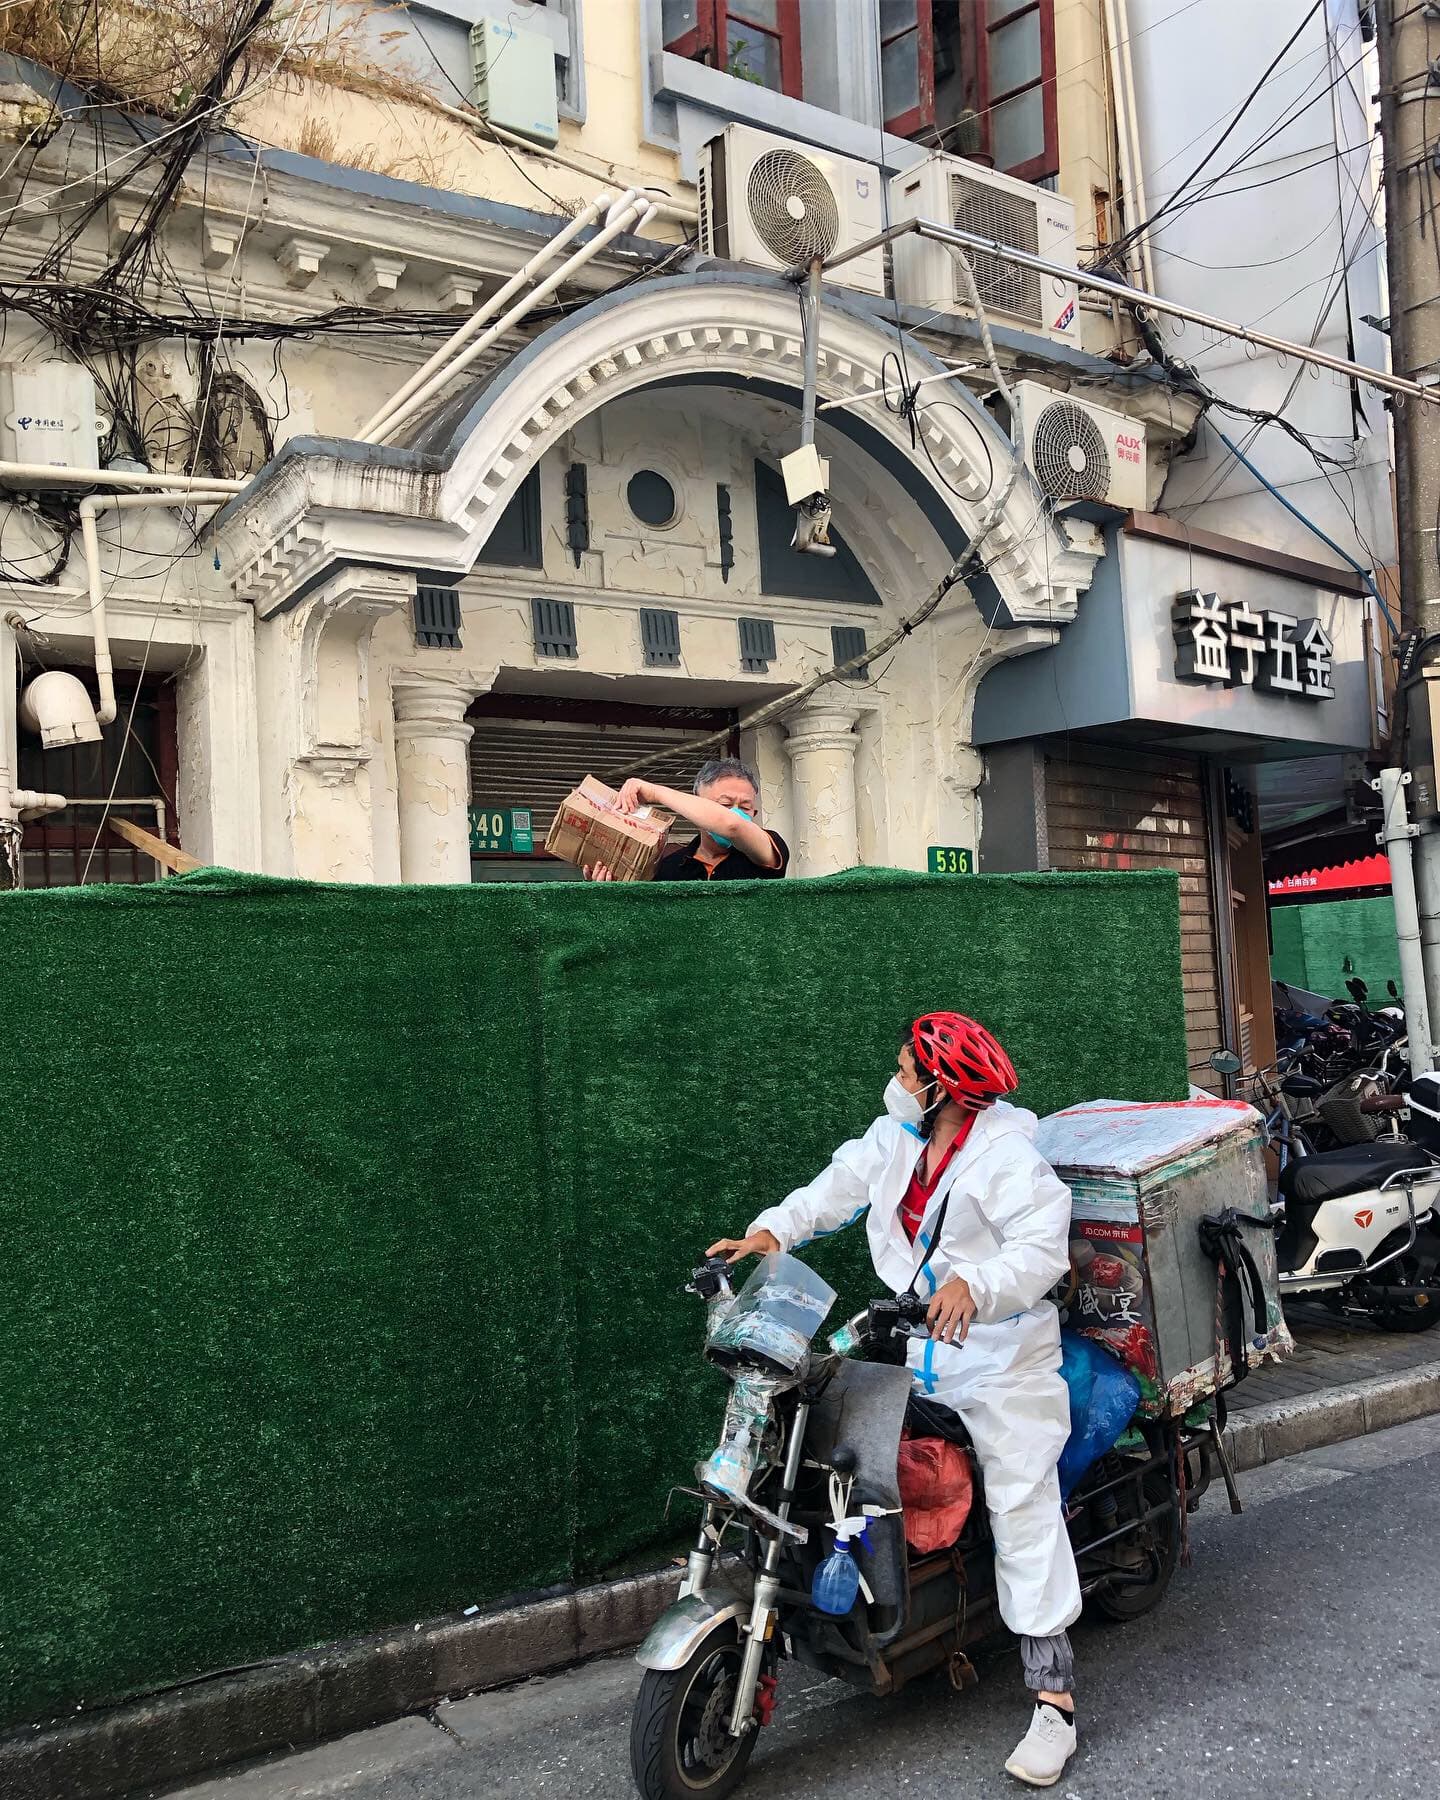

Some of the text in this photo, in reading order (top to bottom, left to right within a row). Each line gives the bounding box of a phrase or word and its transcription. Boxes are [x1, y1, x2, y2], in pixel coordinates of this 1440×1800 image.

[1116, 433, 1141, 450] AUX
[1179, 588, 1336, 699] 益宁五金
[936, 850, 968, 873] 536
[1085, 1227, 1129, 1239] JD.COM 京东
